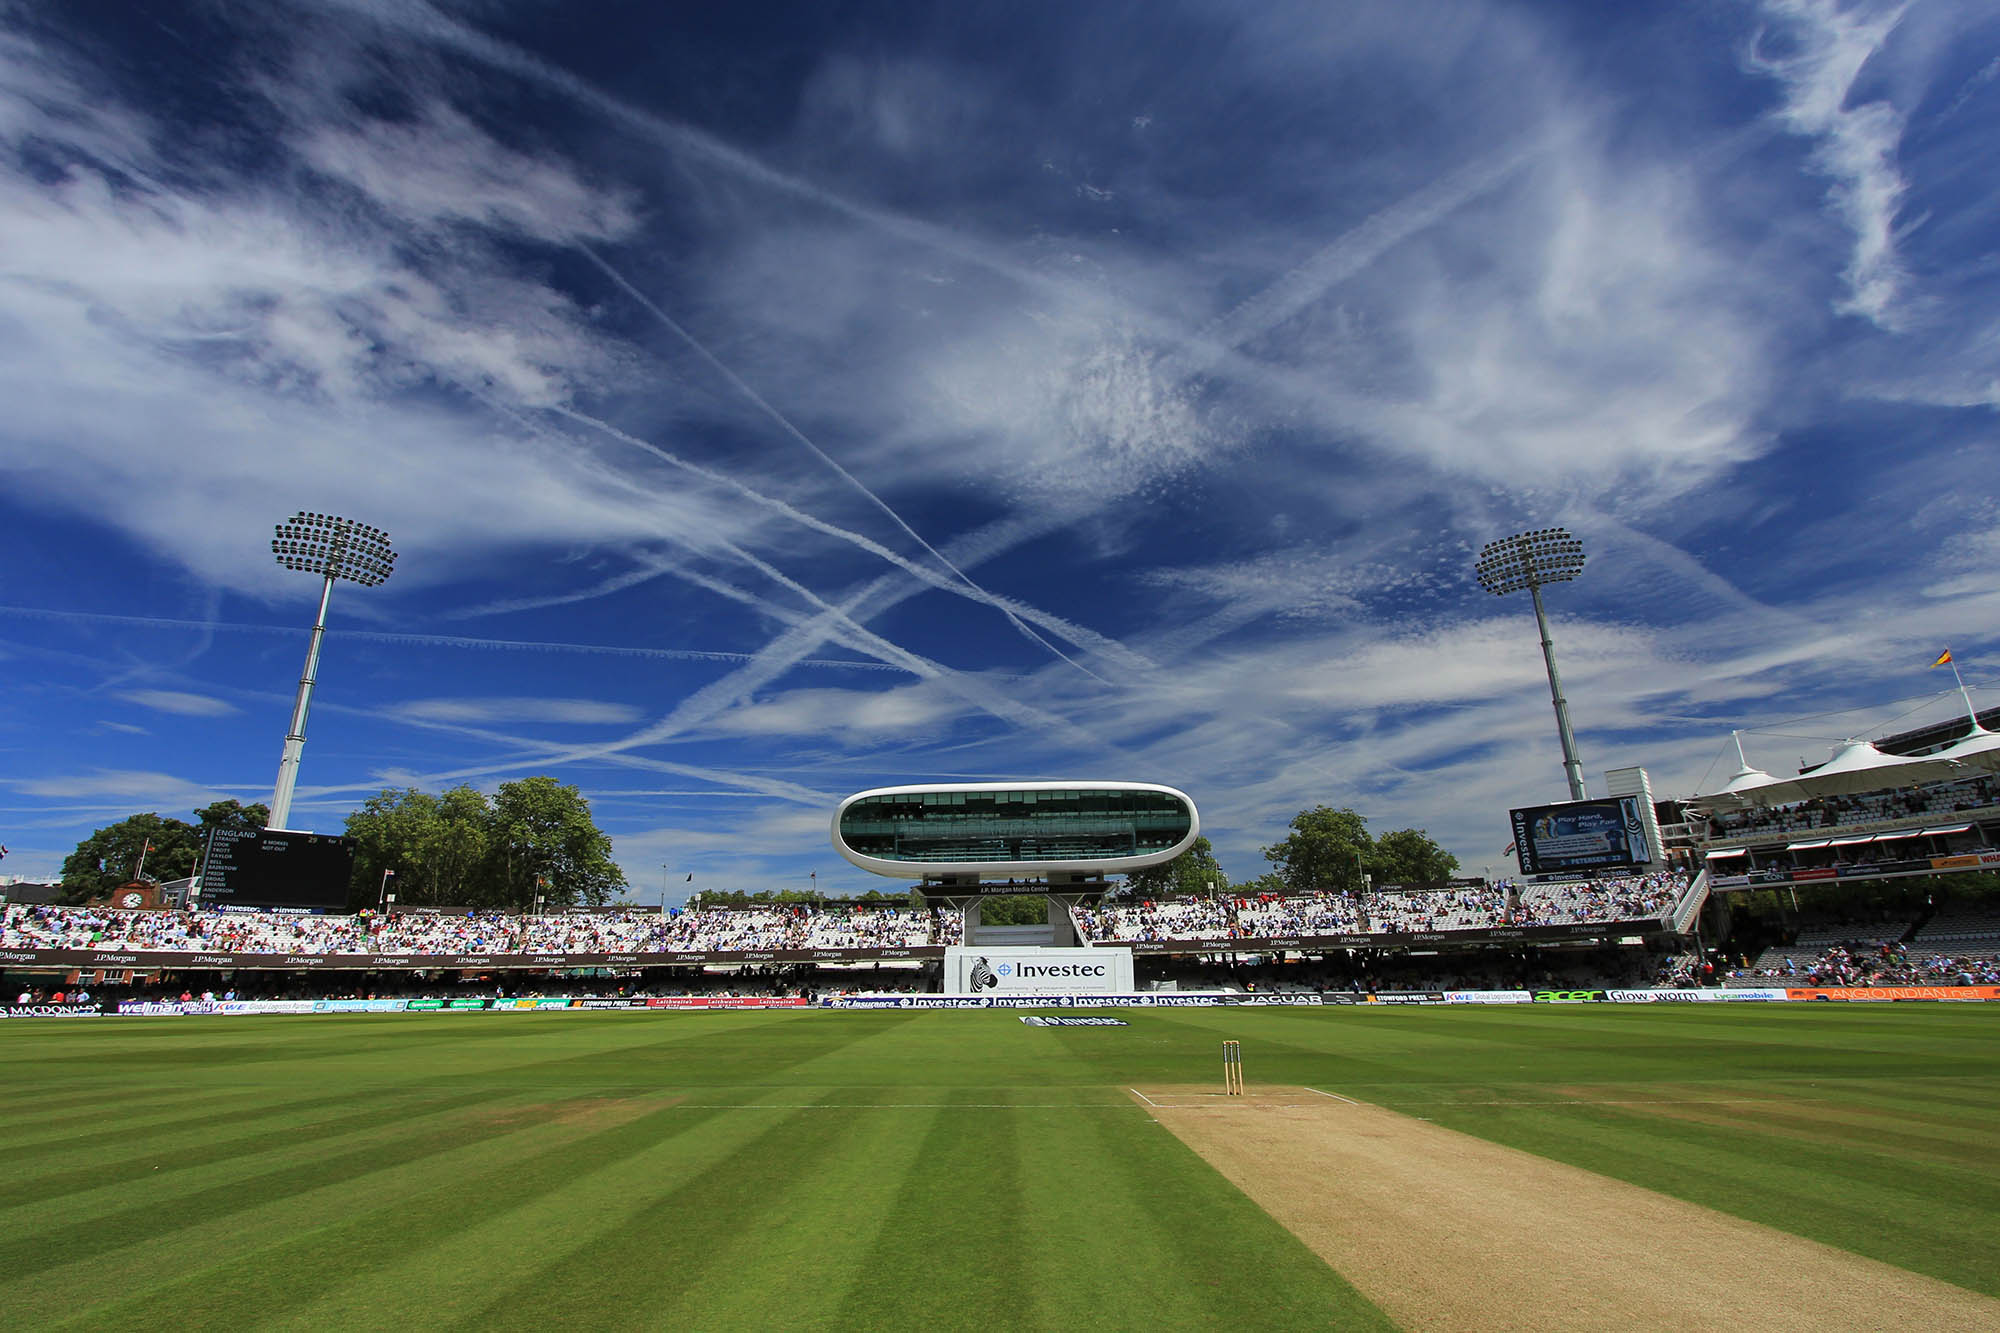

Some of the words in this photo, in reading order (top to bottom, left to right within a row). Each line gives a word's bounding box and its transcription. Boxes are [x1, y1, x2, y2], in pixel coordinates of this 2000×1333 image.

[216, 830, 256, 838] ENGLAND
[1515, 821, 1532, 871] Investec
[1601, 870, 1631, 878] Instec
[279, 906, 312, 915] Investec
[1016, 962, 1105, 978] Investec
[913, 998, 977, 1007] Investec
[993, 997, 1057, 1007] Investec
[1074, 996, 1138, 1007] Investec
[1153, 995, 1218, 1006] Investec
[1512, 992, 1530, 1000] Partner
[1534, 991, 1602, 1001] acer
[118, 1001, 183, 1013] wellman
[831, 999, 850, 1008] Brit
[850, 1000, 895, 1008] Insurance
[1055, 1016, 1128, 1026] Investec
